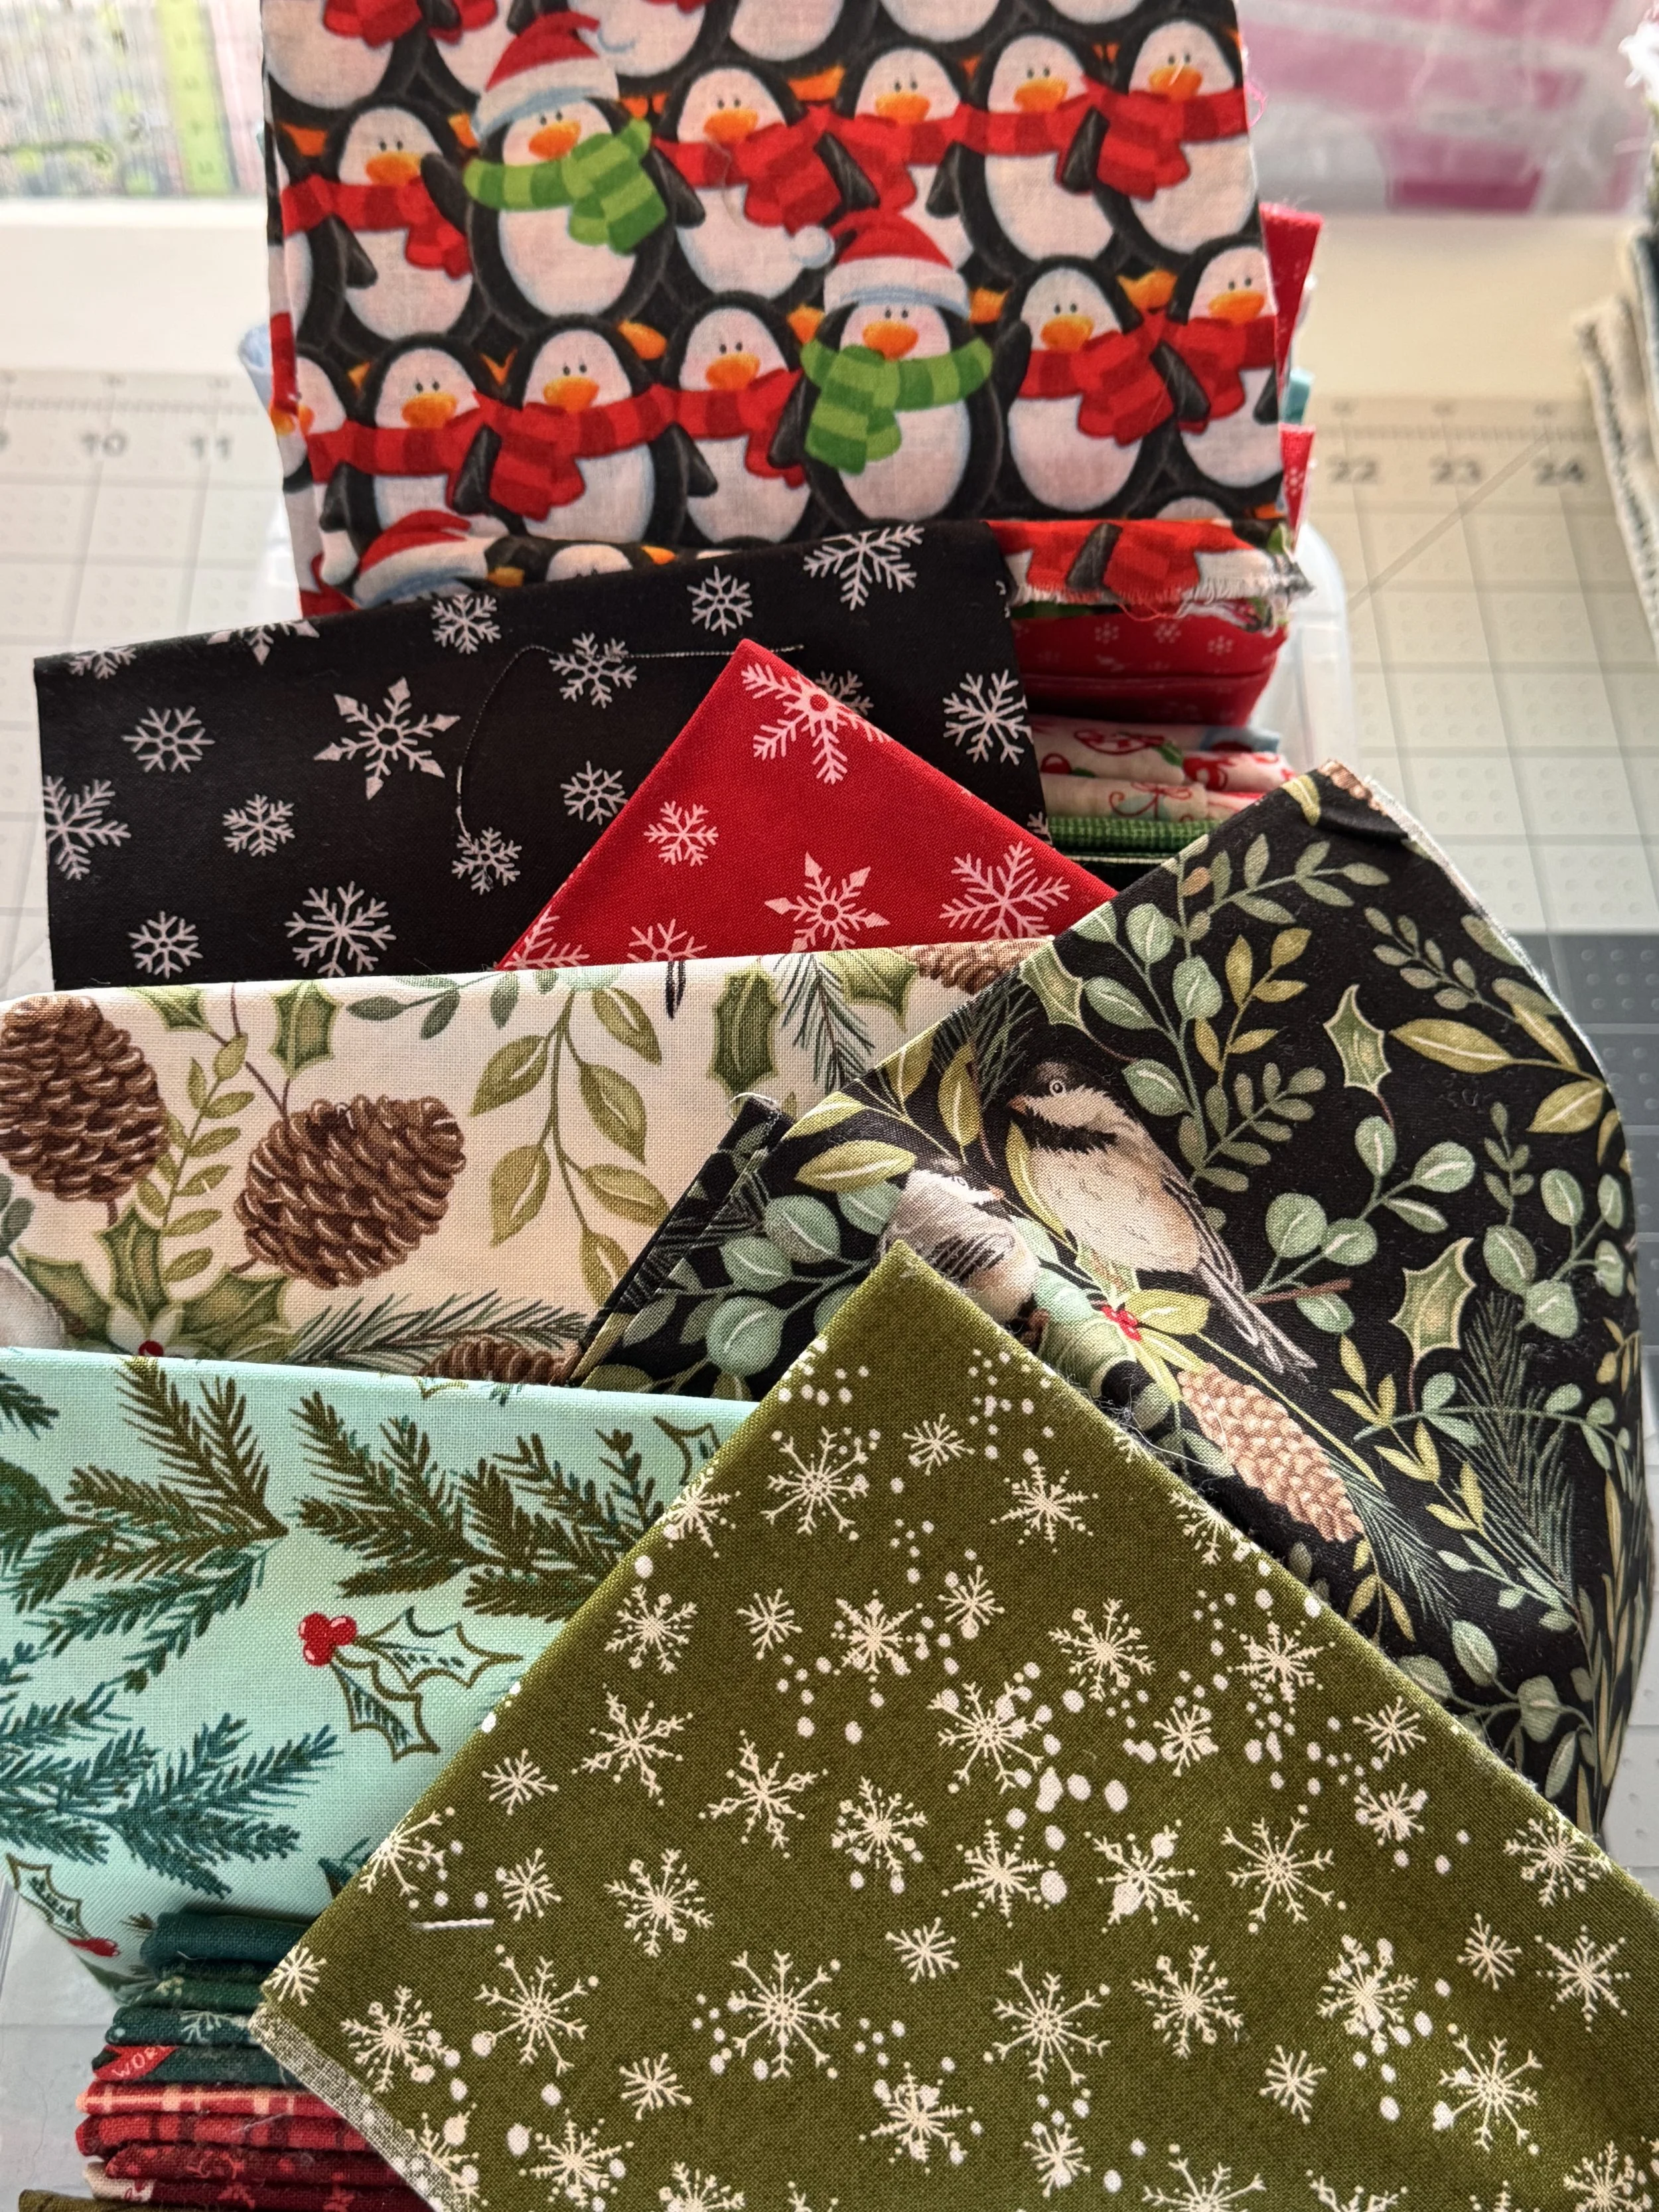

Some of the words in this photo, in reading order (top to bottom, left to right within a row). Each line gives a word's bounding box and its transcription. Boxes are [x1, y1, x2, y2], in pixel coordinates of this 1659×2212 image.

[80, 429, 129, 457] 10
[190, 433, 232, 459] 11
[1327, 457, 1379, 484] 22
[1430, 456, 1481, 484] 23
[1533, 456, 1585, 485] 24
[111, 2046, 167, 2077] WOR
